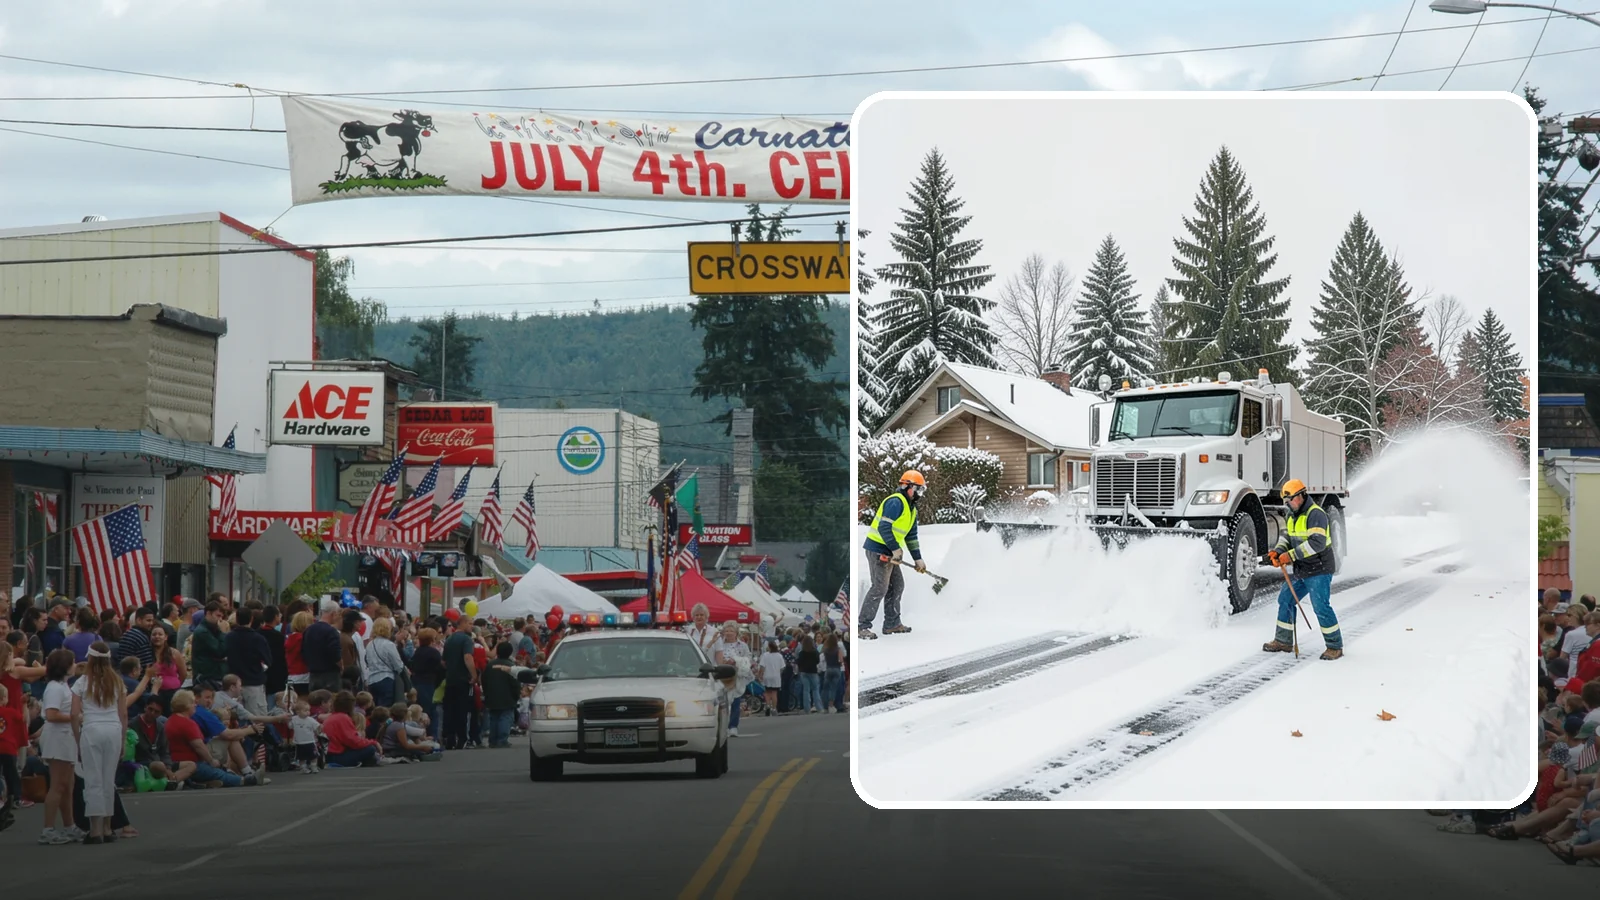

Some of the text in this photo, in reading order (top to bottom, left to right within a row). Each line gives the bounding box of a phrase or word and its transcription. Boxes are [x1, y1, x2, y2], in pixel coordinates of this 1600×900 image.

[481, 140, 605, 193] JULY
[632, 149, 747, 198] 4th.
[696, 253, 850, 280] CROSSWA
[282, 380, 374, 420] ACE
[405, 408, 485, 422] CEDAR LOG
[283, 421, 371, 436] Hardware
[416, 428, 477, 447] Coca-Cola
[353, 467, 384, 481] Simpl
[83, 485, 155, 495] St. Vincent de Paul
[688, 526, 742, 535] CRNATION
[699, 535, 731, 543] GLASS
